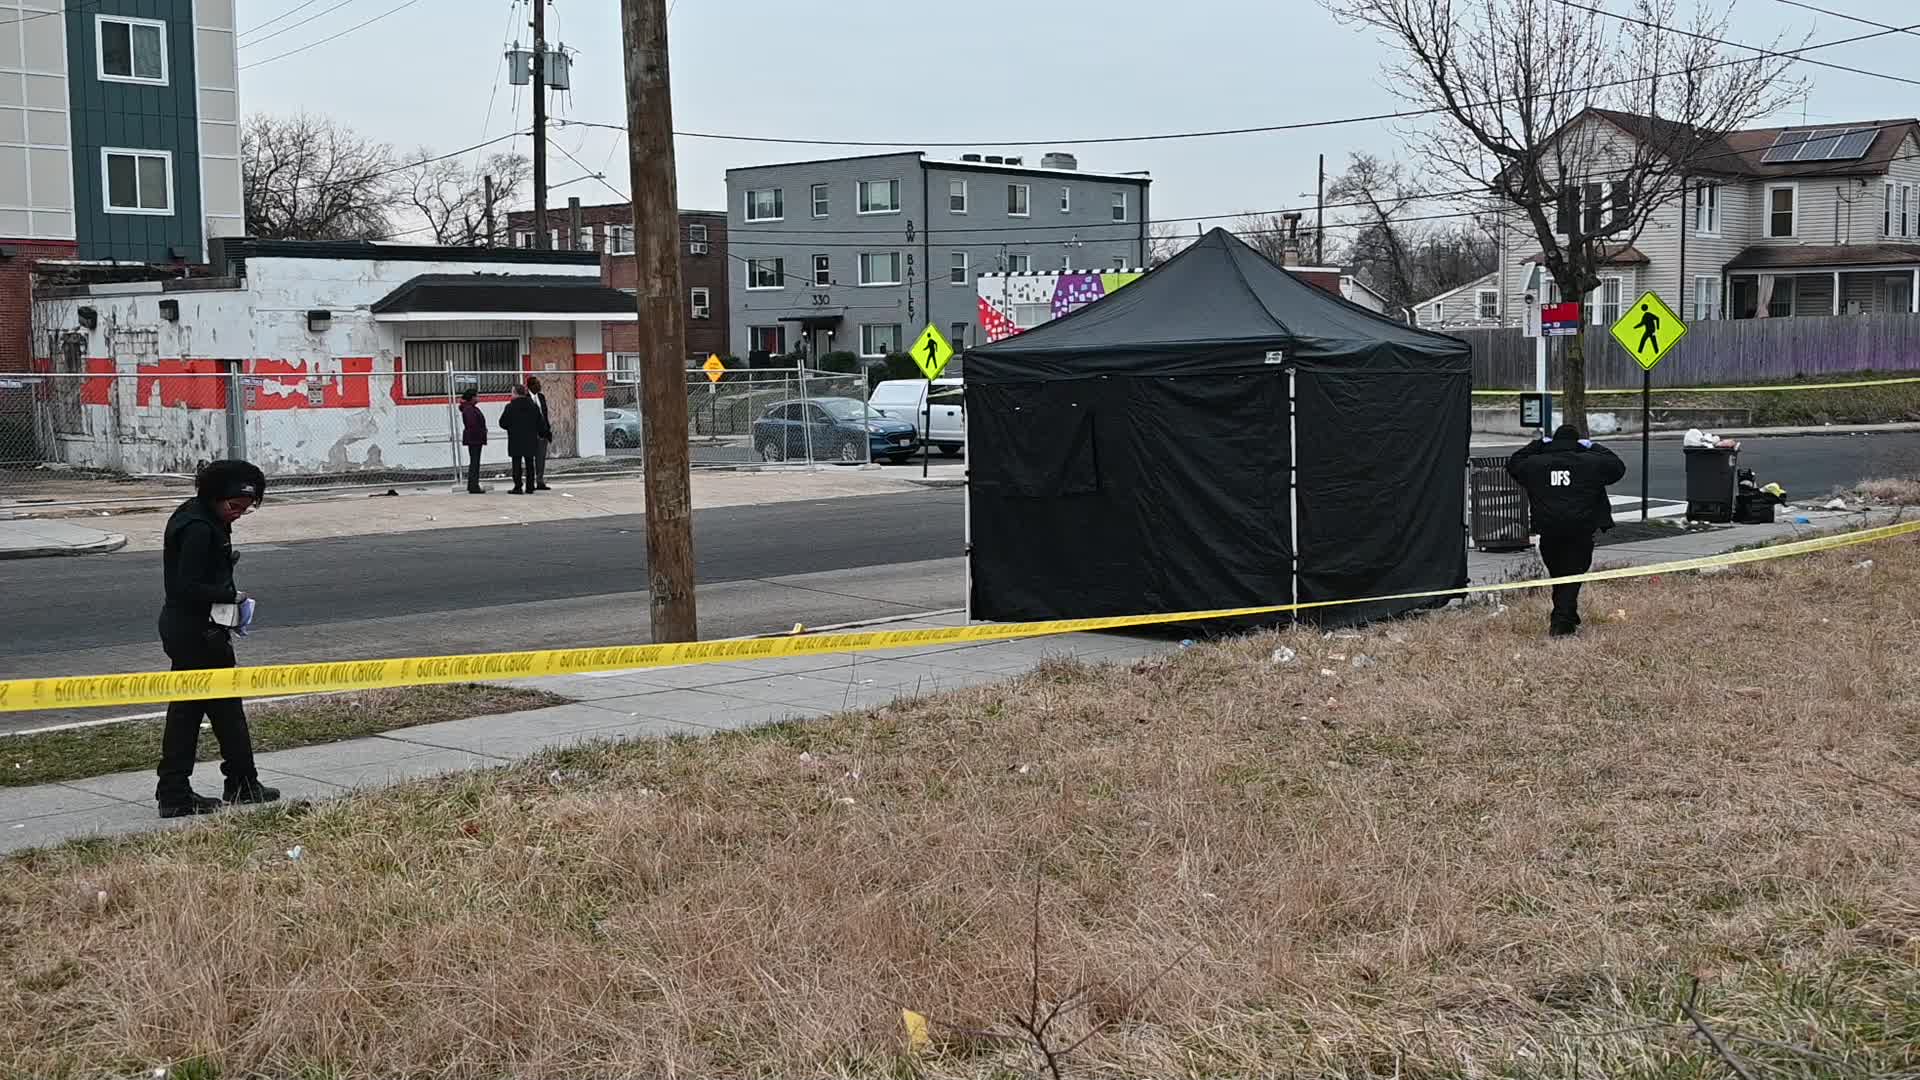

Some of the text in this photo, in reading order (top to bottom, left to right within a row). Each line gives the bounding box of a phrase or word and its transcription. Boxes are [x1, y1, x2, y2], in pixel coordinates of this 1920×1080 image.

[907, 254, 915, 323] BAILEY
[811, 295, 830, 306] 330
[1550, 470, 1571, 486] DFS
